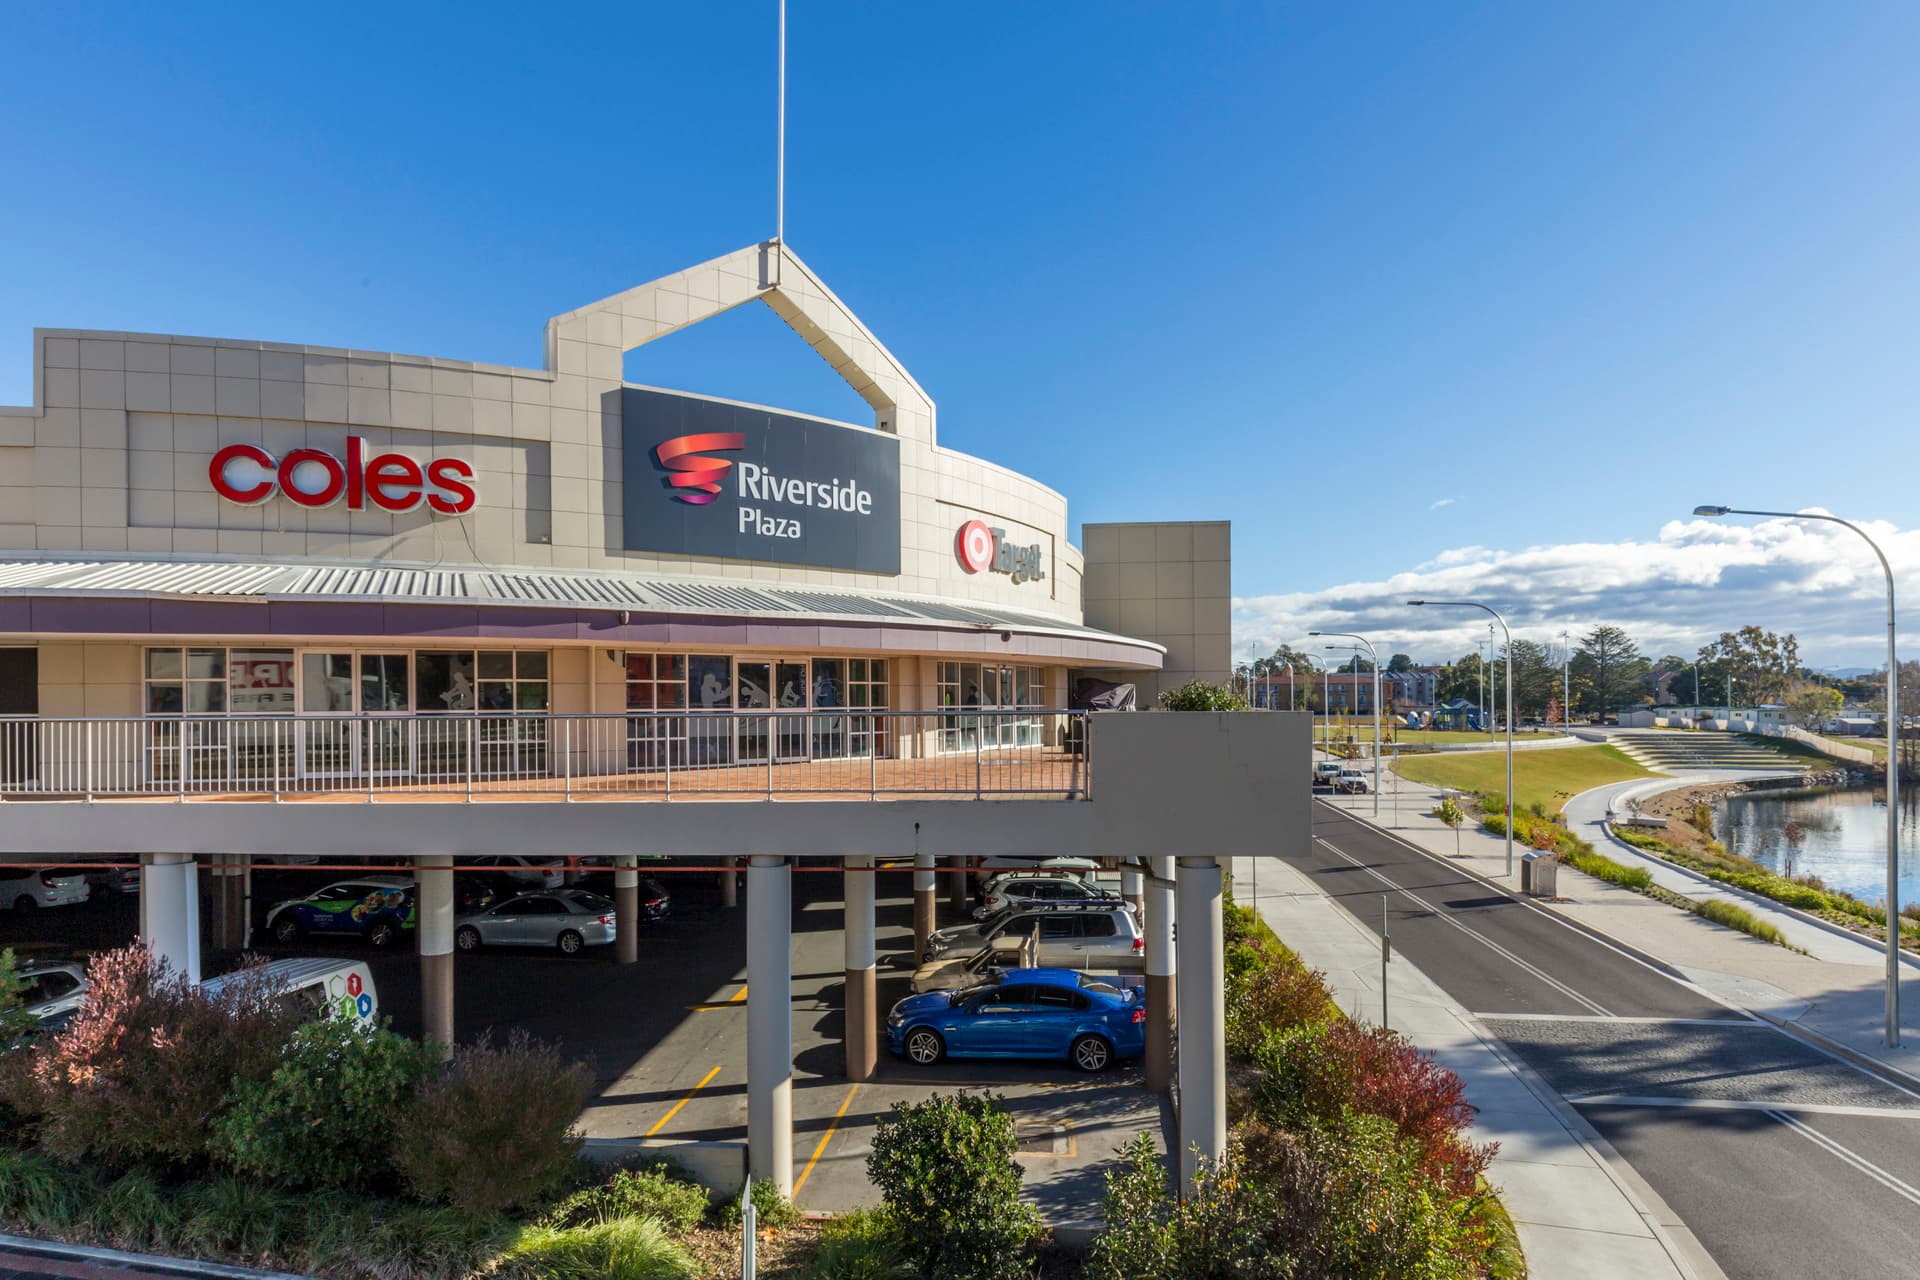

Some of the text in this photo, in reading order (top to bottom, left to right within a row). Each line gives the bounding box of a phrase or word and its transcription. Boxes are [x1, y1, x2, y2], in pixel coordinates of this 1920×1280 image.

[209, 436, 477, 515] coles
[738, 461, 872, 515] Riverside
[738, 507, 801, 539] Plaza
